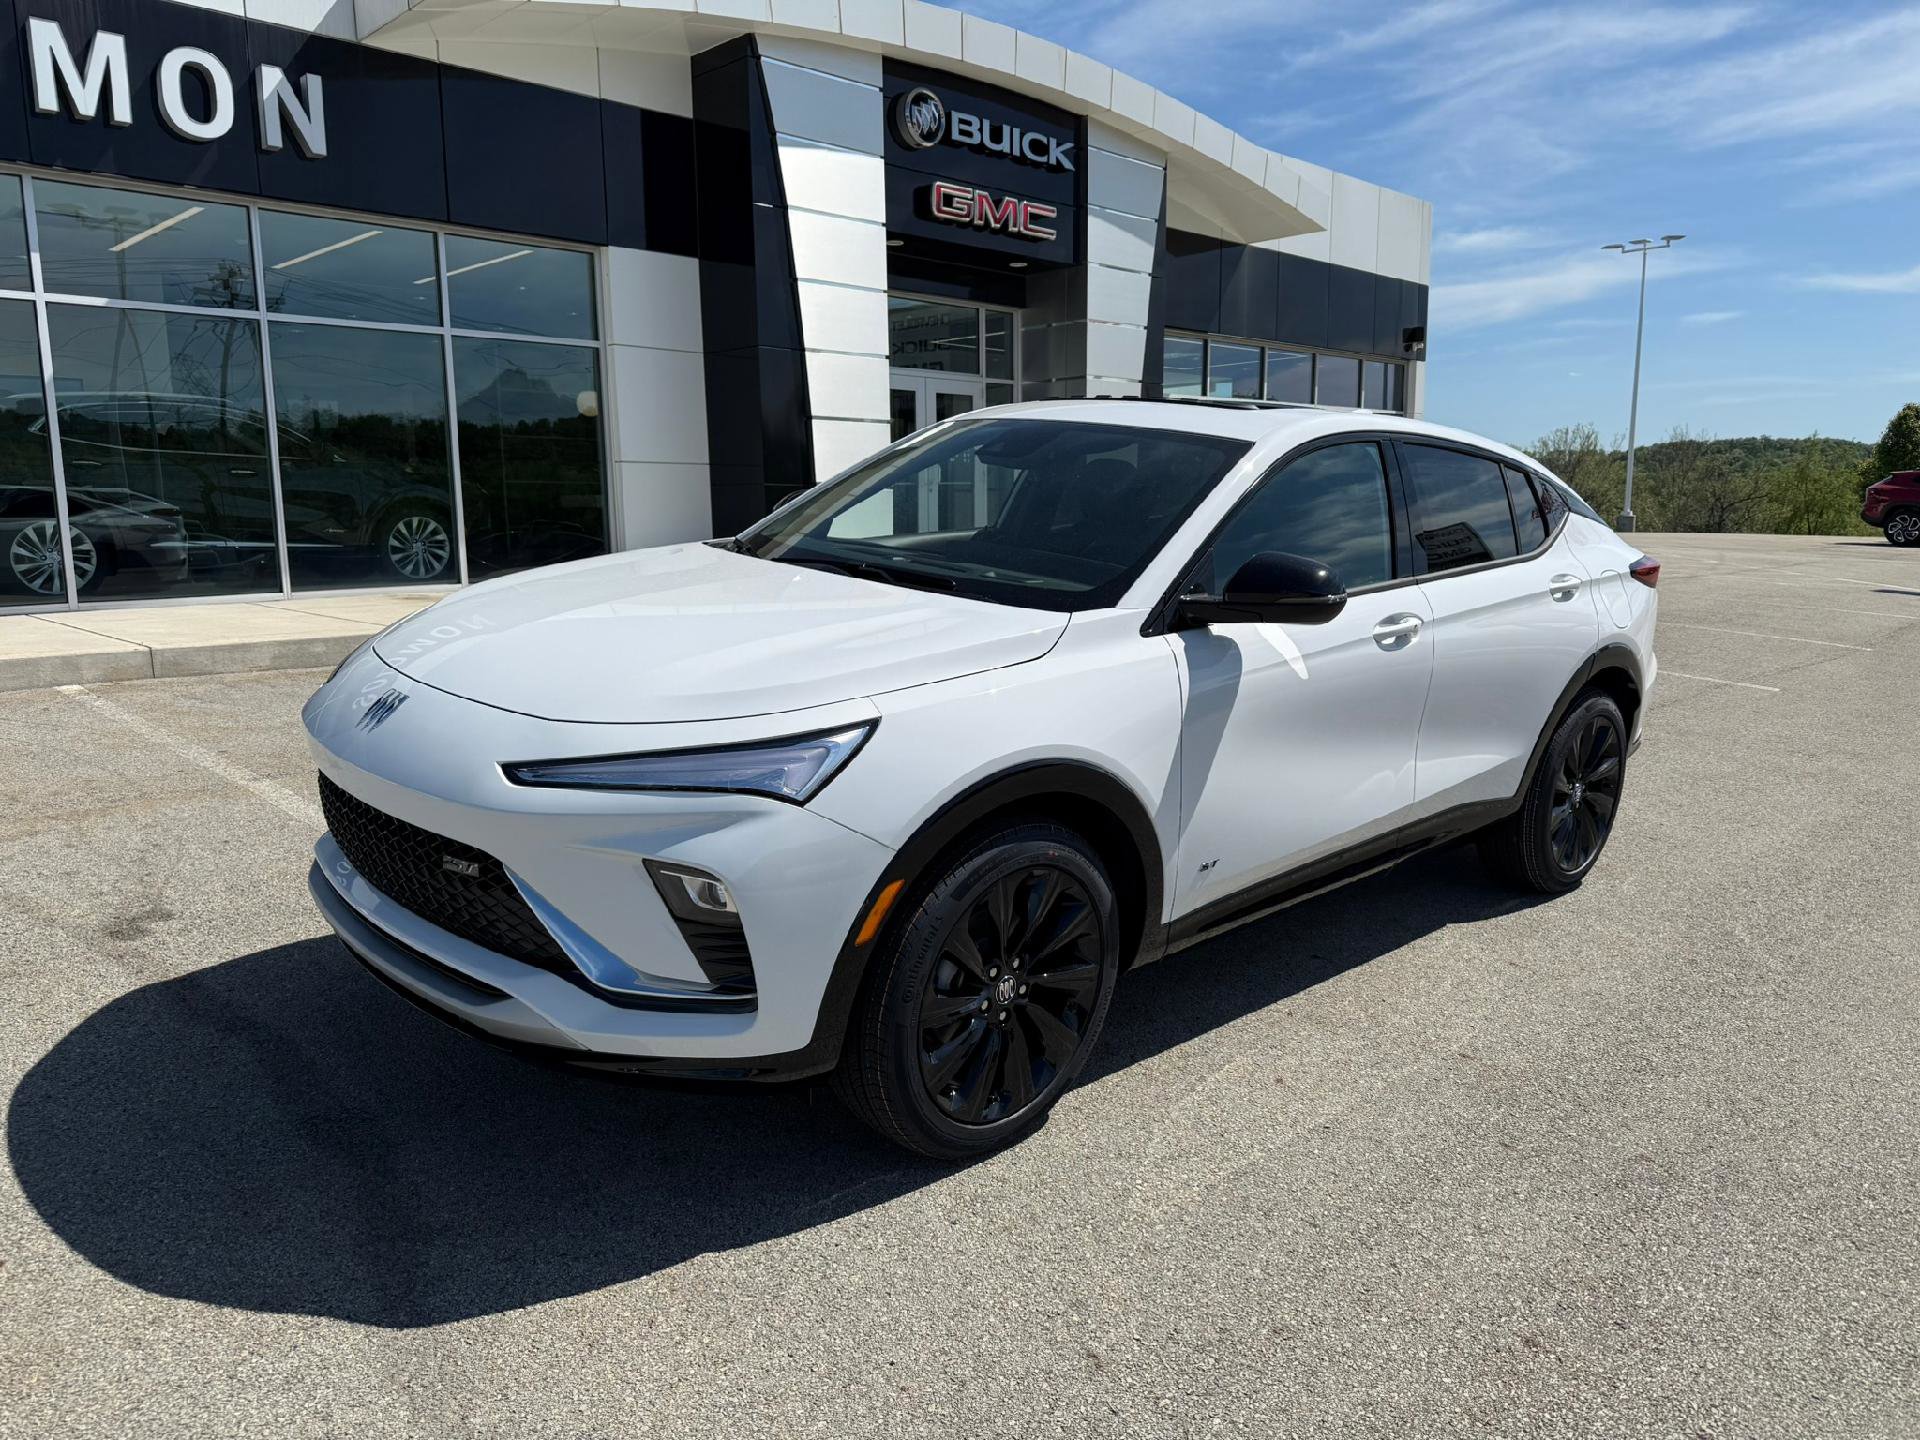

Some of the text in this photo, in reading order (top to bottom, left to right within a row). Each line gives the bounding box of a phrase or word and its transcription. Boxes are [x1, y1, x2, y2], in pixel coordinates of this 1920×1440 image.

[25, 16, 328, 158] MON
[951, 110, 1075, 171] BUICK
[932, 181, 1057, 241] GMC
